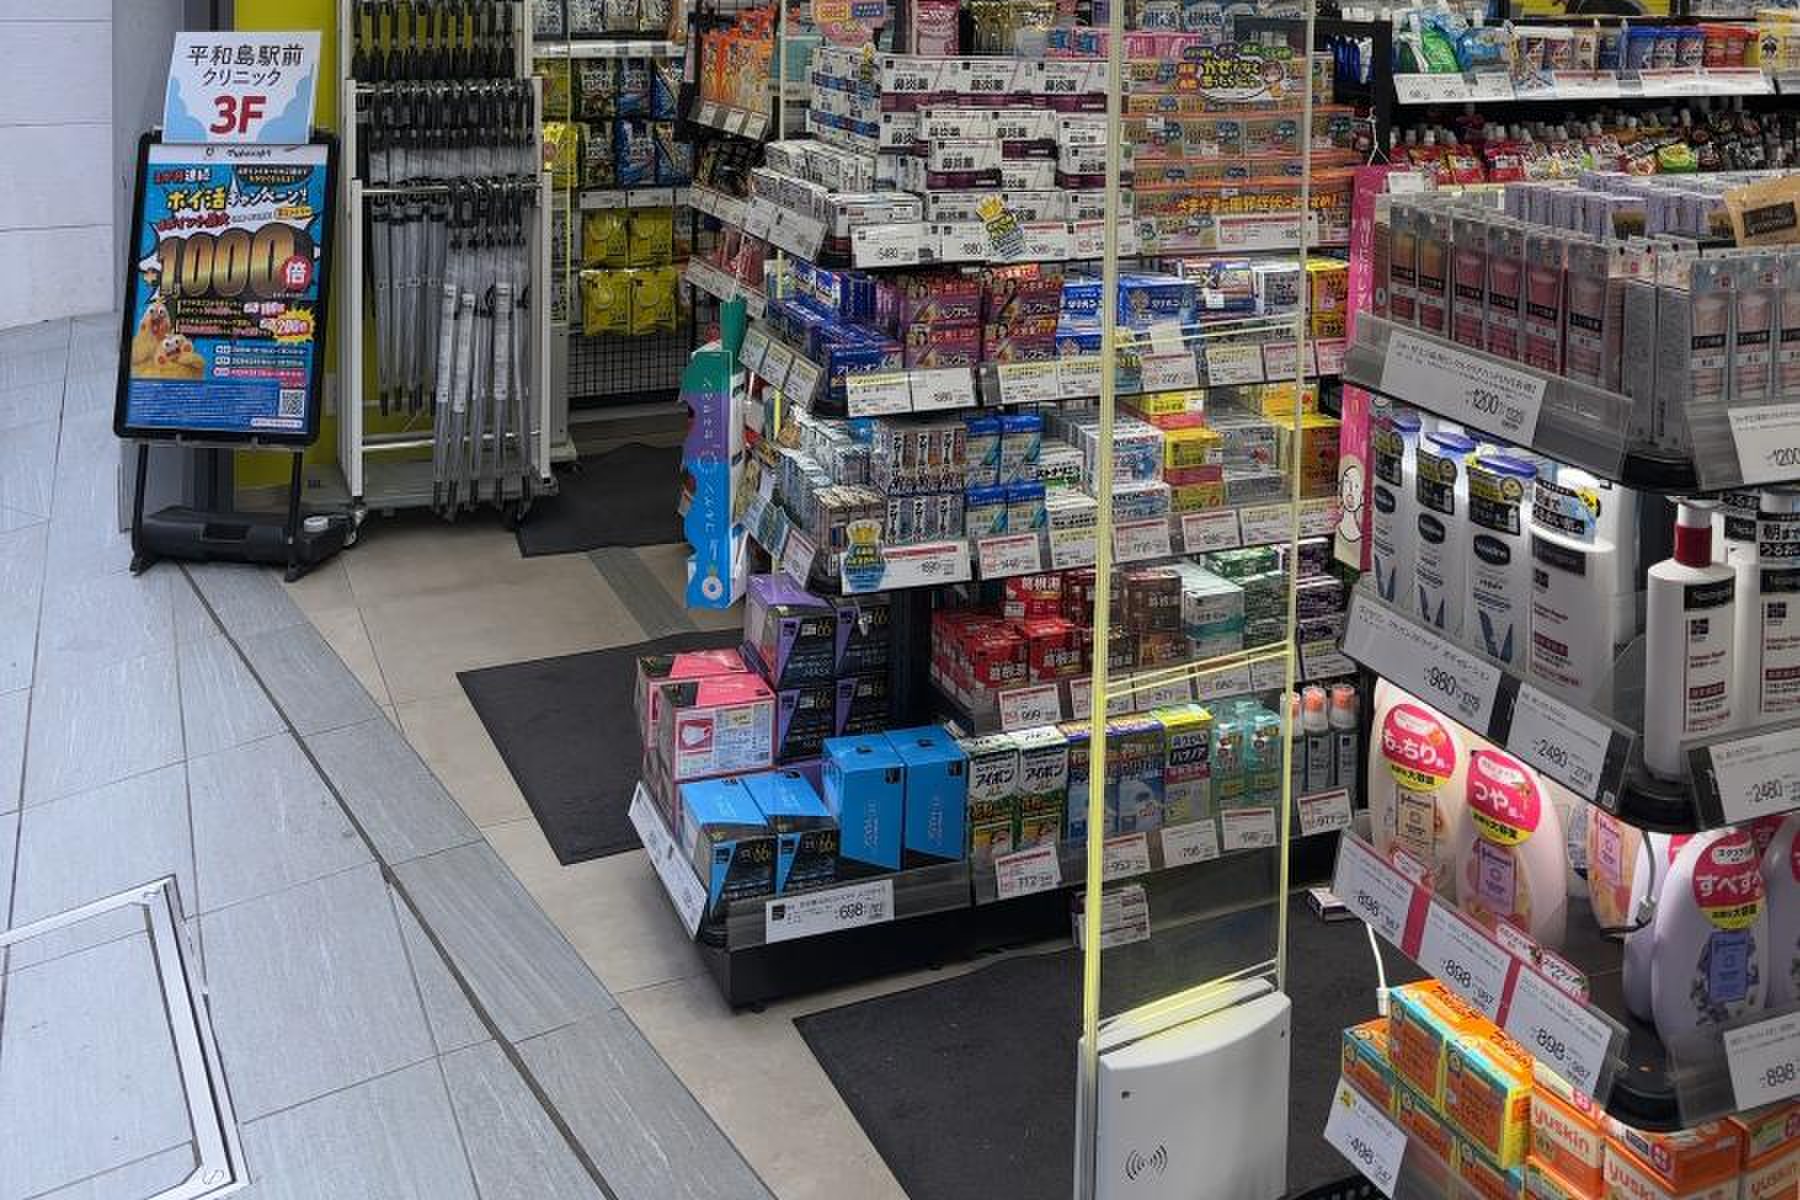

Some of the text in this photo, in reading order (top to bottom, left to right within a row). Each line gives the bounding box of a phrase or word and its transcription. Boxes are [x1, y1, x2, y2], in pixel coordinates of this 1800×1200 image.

[187, 44, 305, 68] 平和島駅前
[202, 68, 282, 87] クリニック
[209, 93, 267, 135] 3F
[1534, 1103, 1591, 1155] yuskin
